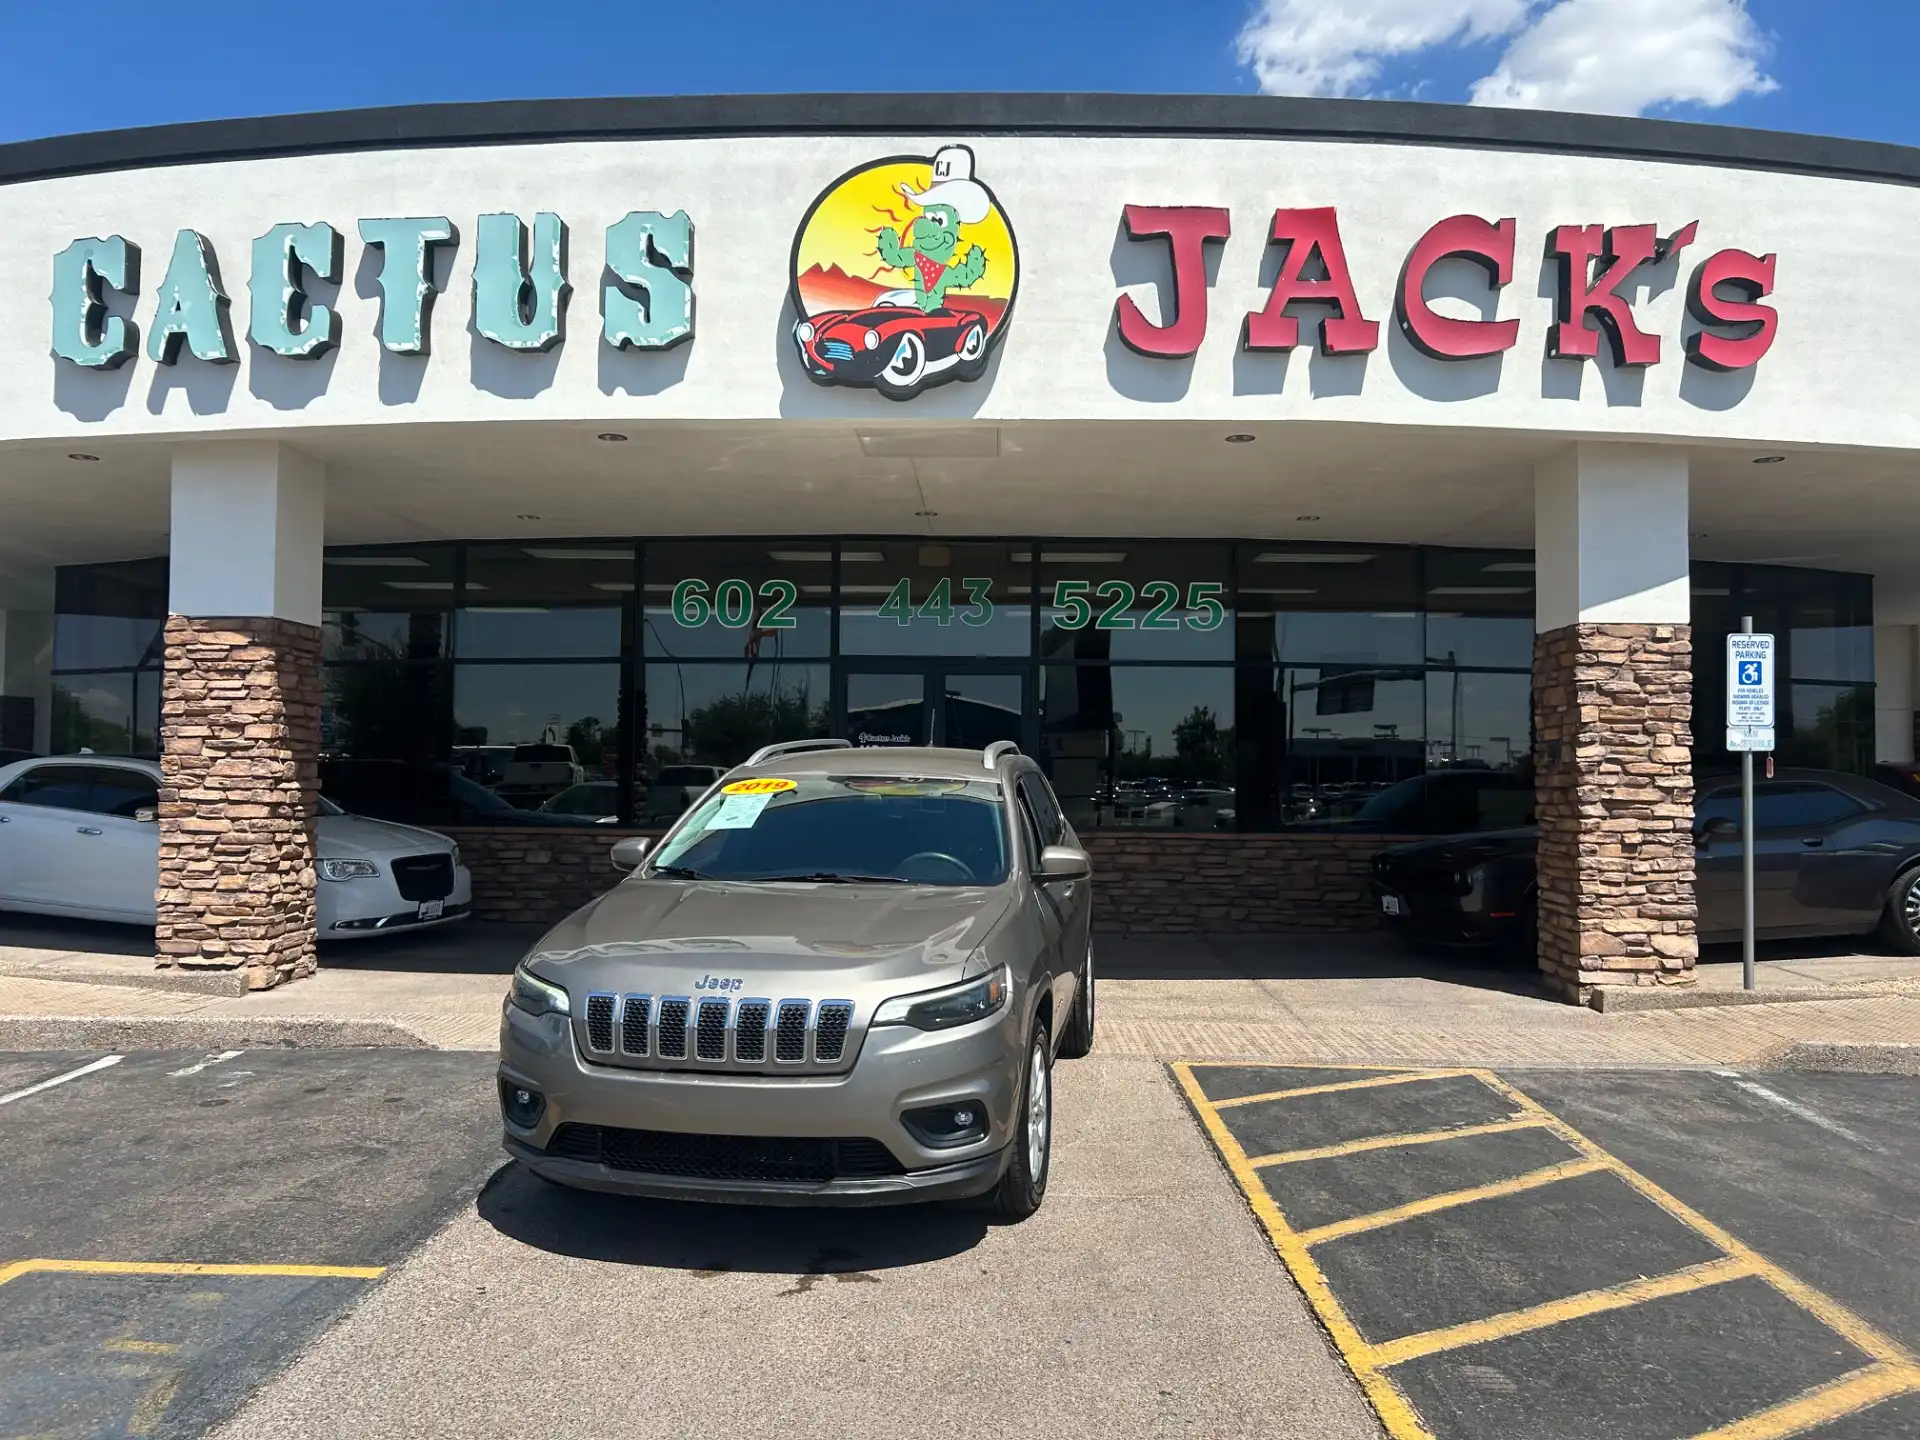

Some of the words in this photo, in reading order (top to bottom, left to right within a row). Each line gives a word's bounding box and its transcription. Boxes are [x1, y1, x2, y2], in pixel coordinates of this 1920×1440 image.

[935, 160, 951, 177] CJ
[49, 210, 695, 370] CACTUS
[671, 578, 798, 629] 602
[877, 577, 995, 628] 443
[1051, 580, 1226, 632] 5225
[1731, 640, 1770, 649] RESERVED
[1735, 651, 1766, 659] PARKING
[1743, 729, 1758, 738] VAN
[1729, 739, 1772, 748] ACESSIBLE
[728, 781, 789, 792] 2019
[694, 974, 744, 993] Jeep
